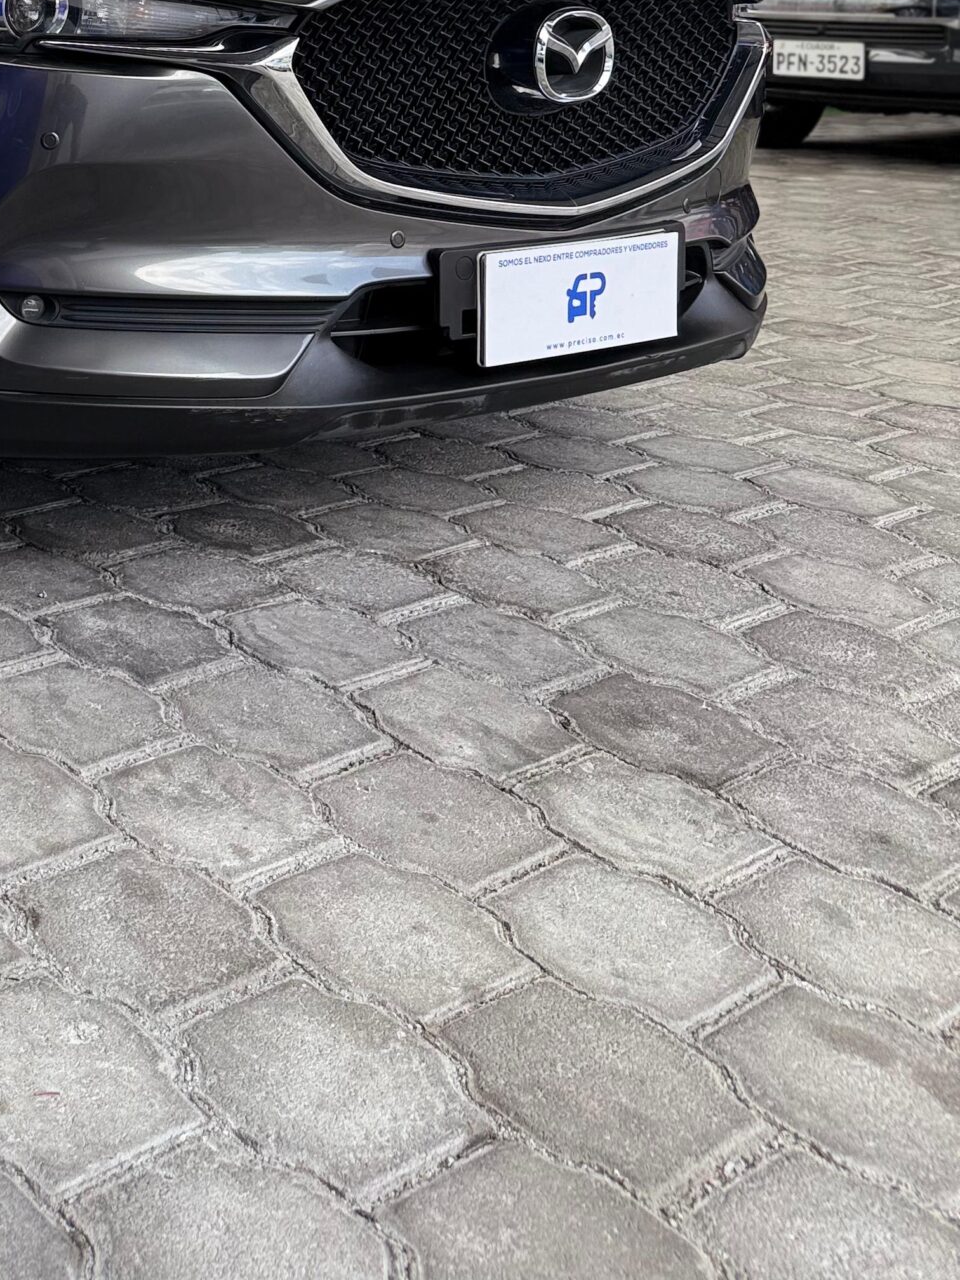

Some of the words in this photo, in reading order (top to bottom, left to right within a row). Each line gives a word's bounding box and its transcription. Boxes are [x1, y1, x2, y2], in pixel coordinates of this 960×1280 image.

[776, 52, 861, 75] PFN-3523
[498, 257, 524, 268] SOMOS
[524, 255, 533, 265] EL
[533, 253, 552, 264] NEXO
[552, 251, 574, 262] ENTRE
[574, 246, 623, 259] COMPRADORES
[623, 245, 629, 253] Y
[628, 240, 668, 252] VENDEDORES
